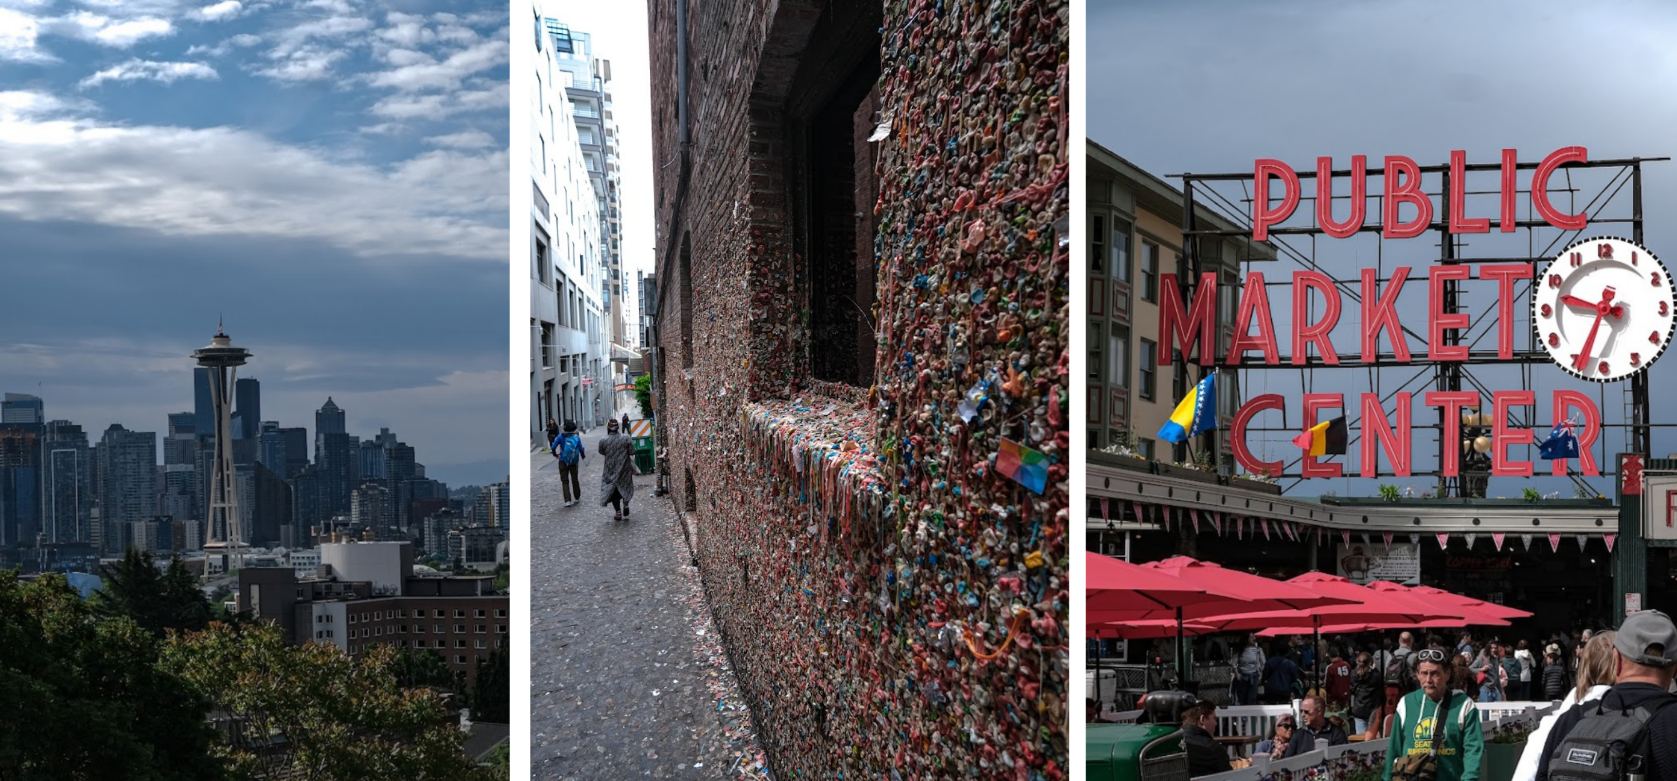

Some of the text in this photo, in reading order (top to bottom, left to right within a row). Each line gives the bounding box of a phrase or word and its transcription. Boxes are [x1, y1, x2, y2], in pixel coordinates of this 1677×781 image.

[1253, 147, 1587, 241] PUBLIC
[1598, 243, 1612, 257] 12
[1570, 252, 1581, 266] 11
[1632, 251, 1637, 265] 1
[1548, 274, 1561, 287] 10
[1650, 272, 1660, 286] 2
[1158, 264, 1533, 365] MARKET
[1541, 303, 1551, 317] 9
[1658, 301, 1668, 315] 3
[1548, 333, 1558, 346] 8
[1648, 331, 1659, 344] 4
[1630, 353, 1640, 366] 5
[1599, 361, 1609, 374] 6
[1230, 390, 1600, 477] CENTER
[1414, 740, 1445, 748] SEATE
[1407, 747, 1456, 756] SUPERNICS
